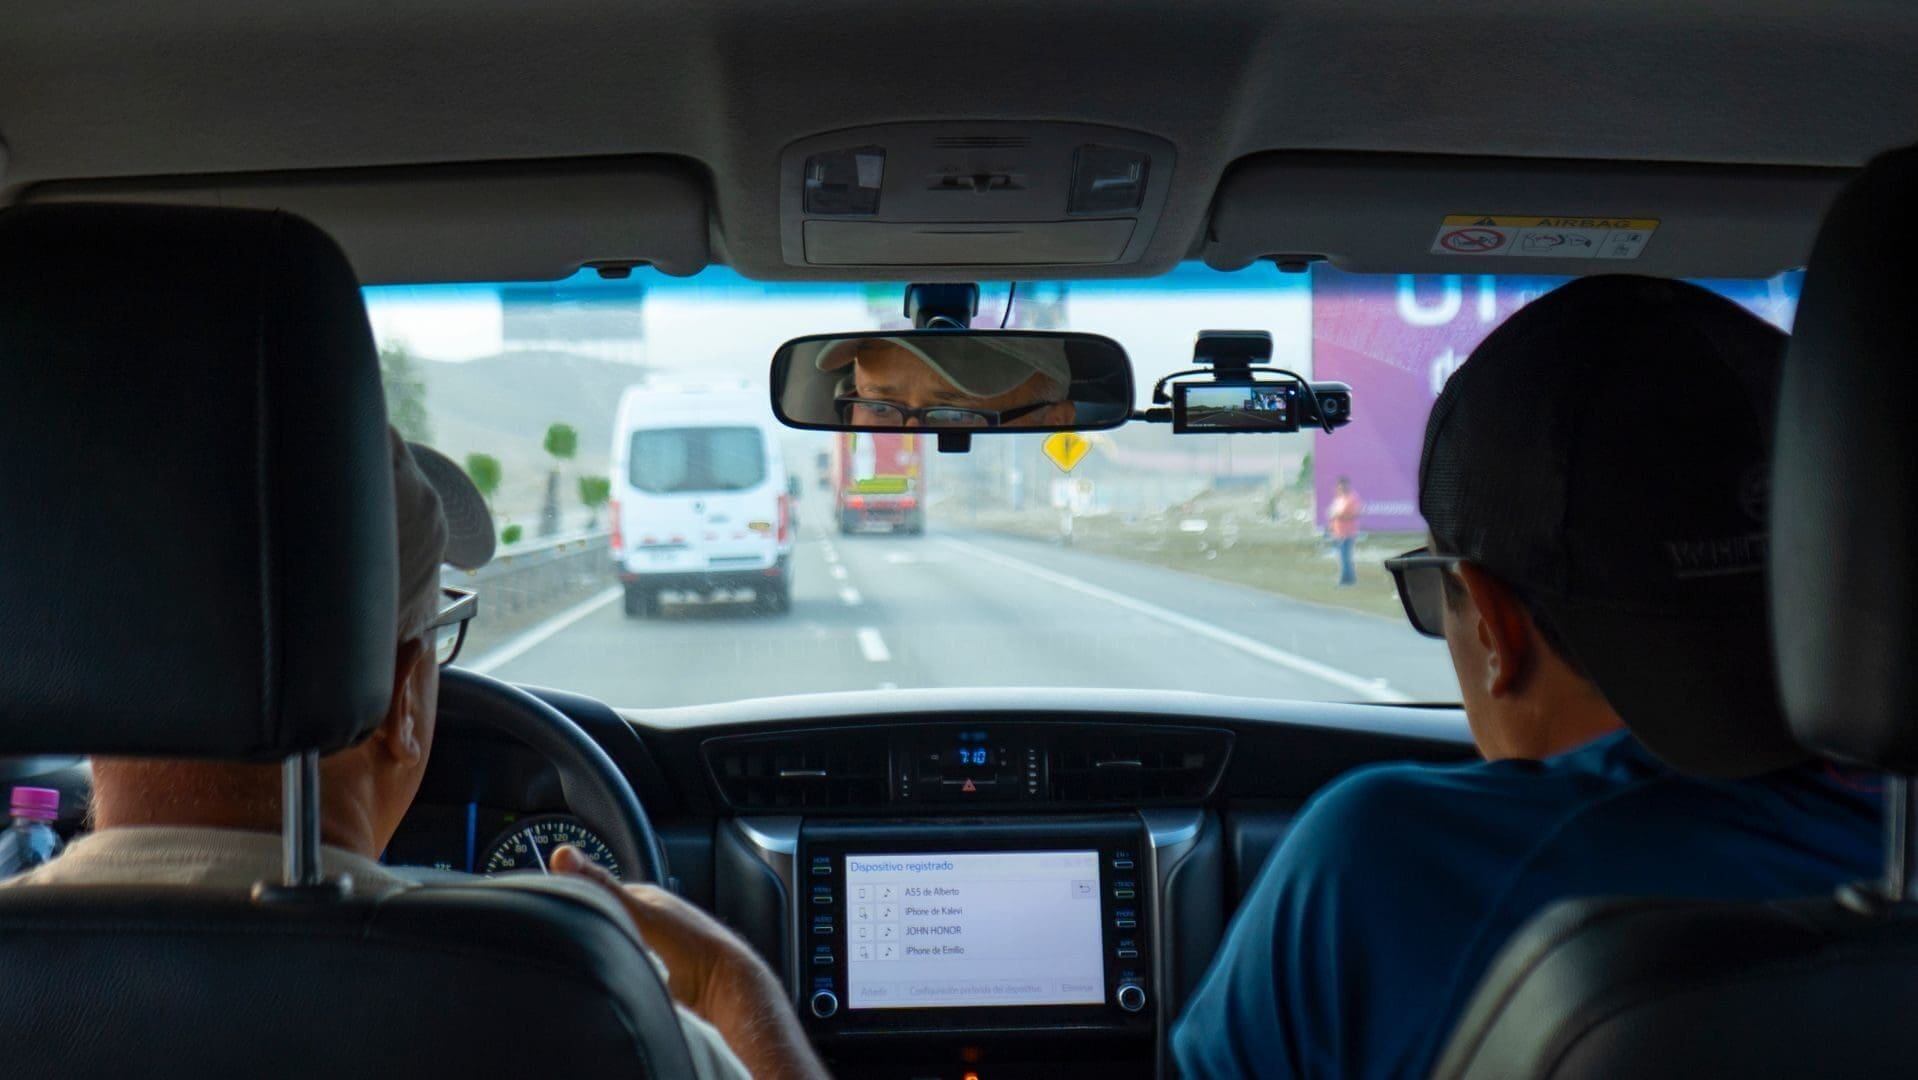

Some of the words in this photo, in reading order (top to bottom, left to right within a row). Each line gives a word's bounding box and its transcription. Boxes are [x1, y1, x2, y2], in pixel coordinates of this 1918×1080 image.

[1537, 218, 1632, 229] AIRBAG
[960, 751, 986, 764] 7:10
[552, 833, 569, 842] 120
[515, 844, 528, 853] 80
[851, 862, 903, 873] Dispositivo
[906, 861, 954, 872] registrado
[905, 888, 921, 897] A55
[923, 888, 932, 896] de
[934, 887, 960, 896] Alberto
[931, 907, 939, 915] de
[941, 906, 963, 915] Kalevi
[906, 926, 929, 936] JOHN
[931, 926, 962, 935] HONOR
[932, 945, 941, 955] de
[943, 945, 965, 954] Emilio
